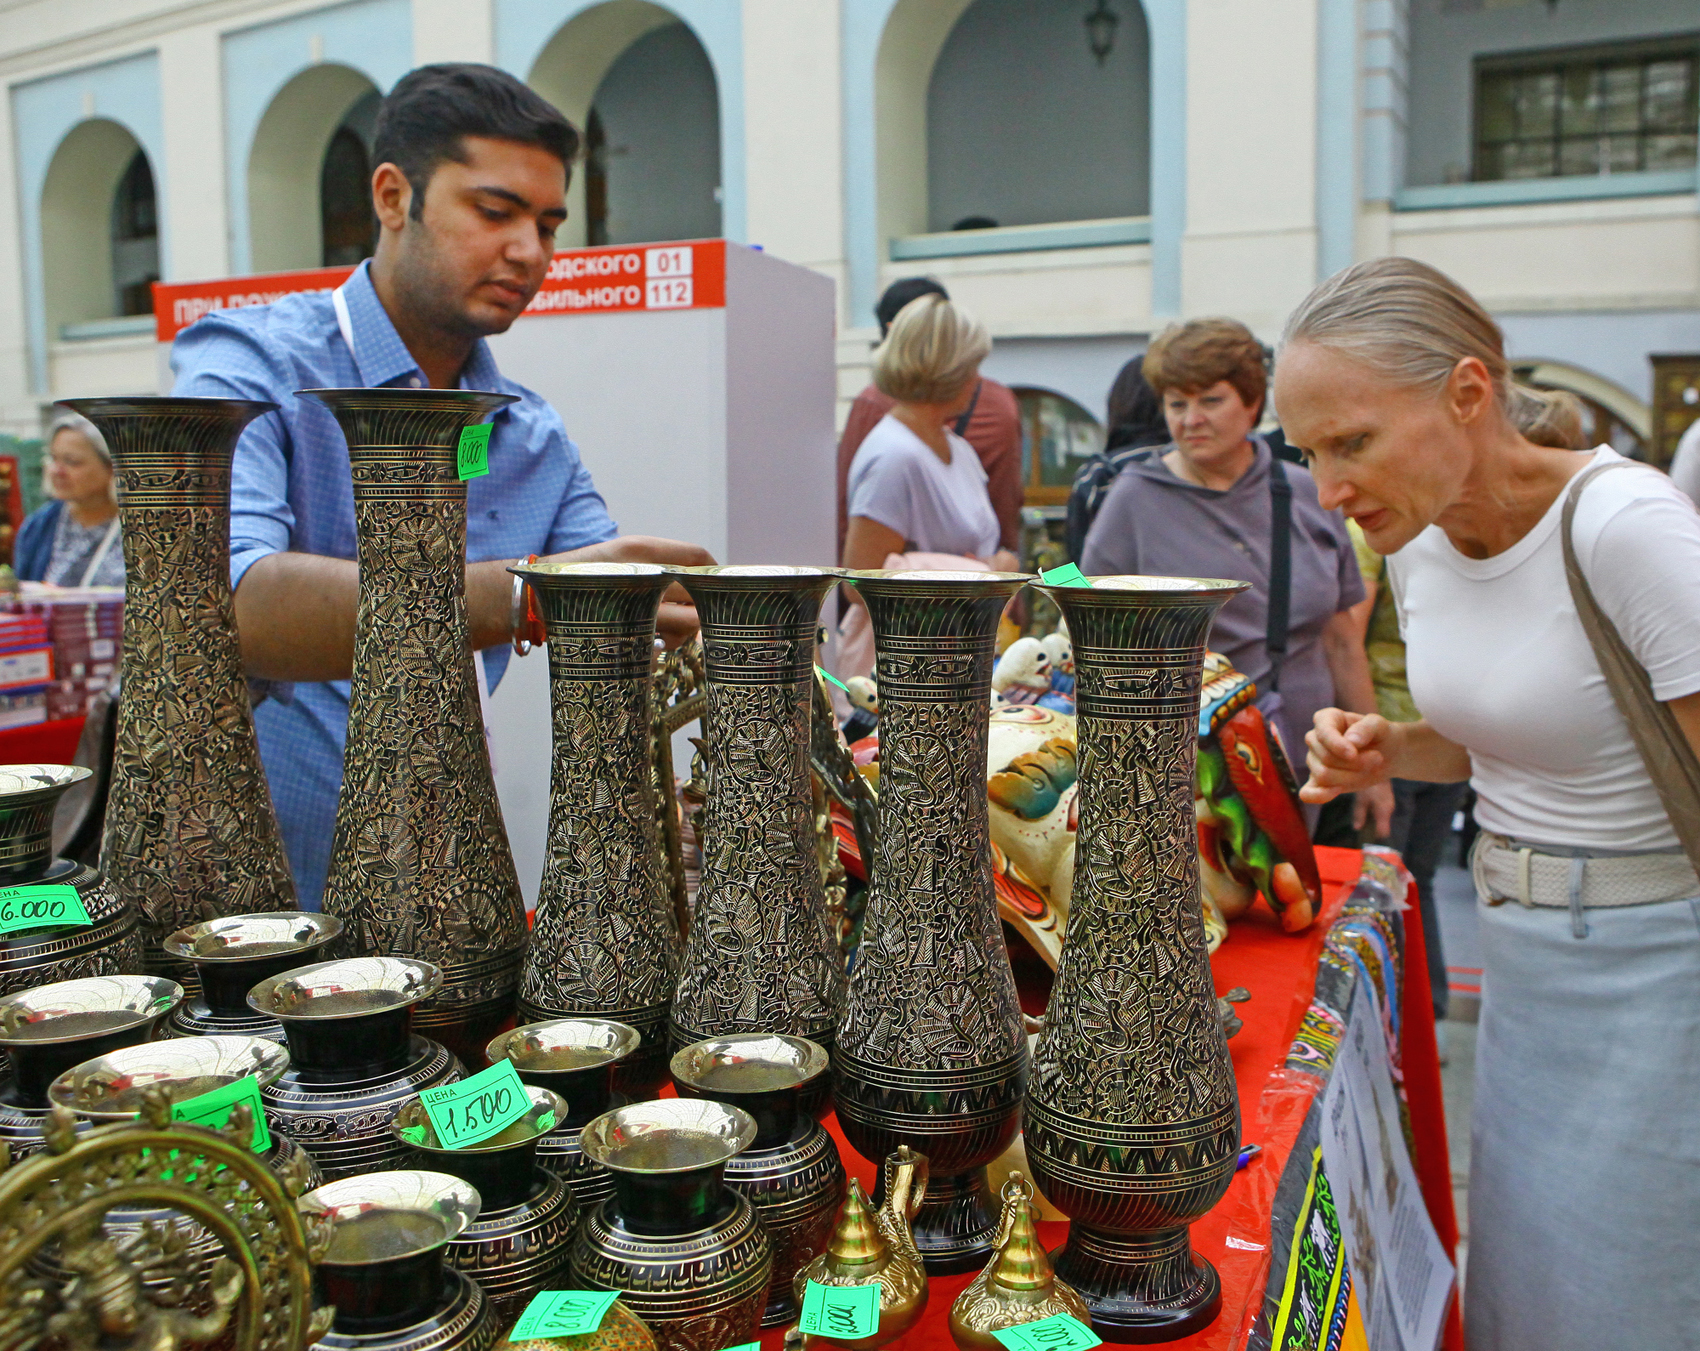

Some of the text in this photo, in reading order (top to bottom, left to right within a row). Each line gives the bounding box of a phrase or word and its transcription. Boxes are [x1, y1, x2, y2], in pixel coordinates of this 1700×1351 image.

[657, 252, 682, 273] 01
[526, 282, 688, 311] БИЛЬНОГО 112
[0, 889, 20, 898] НА
[425, 1088, 458, 1103] ЦЕНА
[445, 1087, 512, 1138] 1.500
[804, 1311, 819, 1331] ЦЕНА
